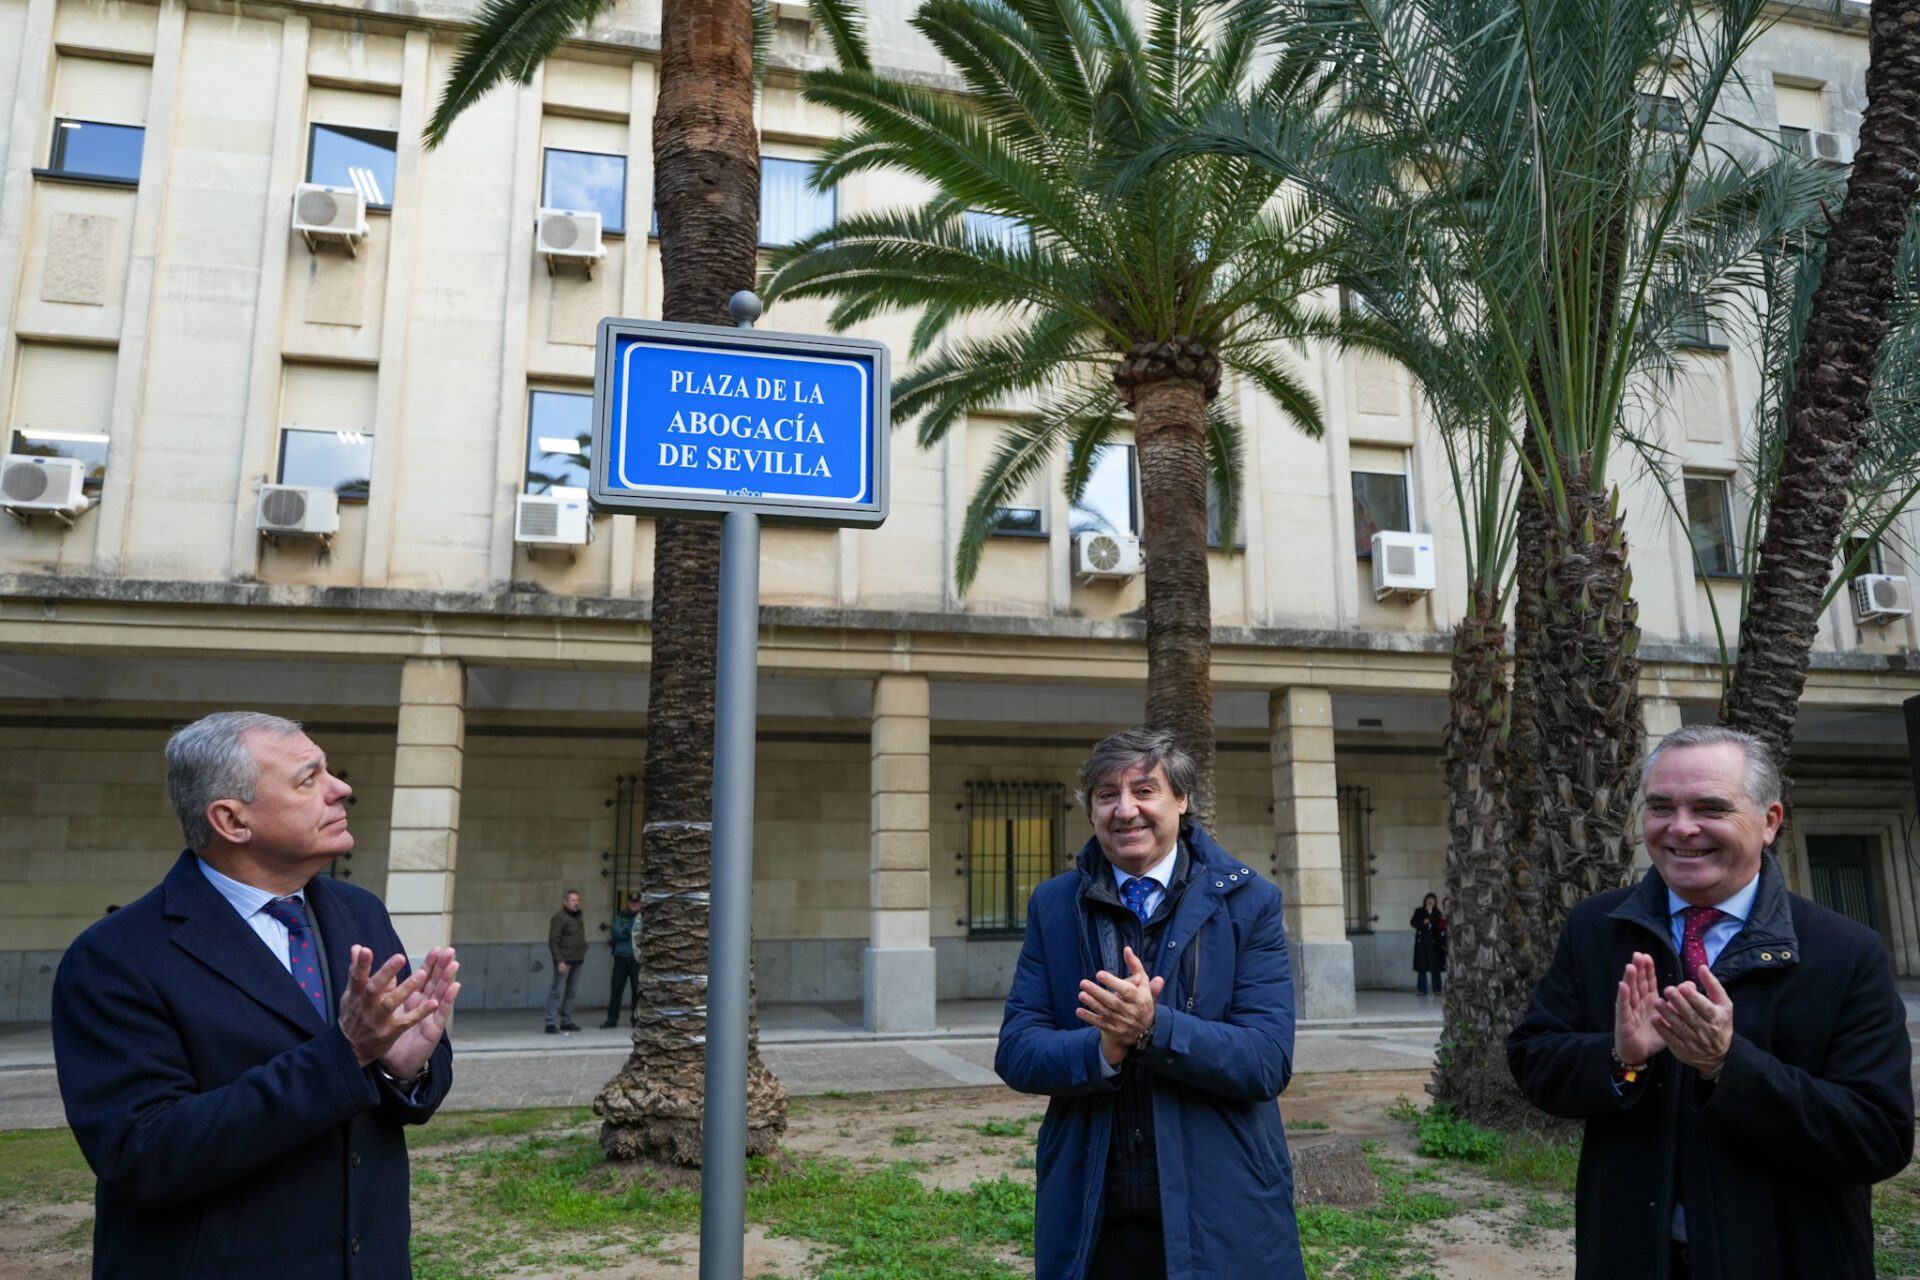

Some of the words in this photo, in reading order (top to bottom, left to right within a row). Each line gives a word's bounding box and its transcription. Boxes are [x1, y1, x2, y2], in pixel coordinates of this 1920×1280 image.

[670, 370, 750, 399] PLAZA
[755, 377, 787, 401] DE
[793, 380, 825, 405] LA
[667, 410, 825, 444] ABOGACÍA
[658, 443, 698, 468] DE
[706, 446, 832, 478] SEVILLA
